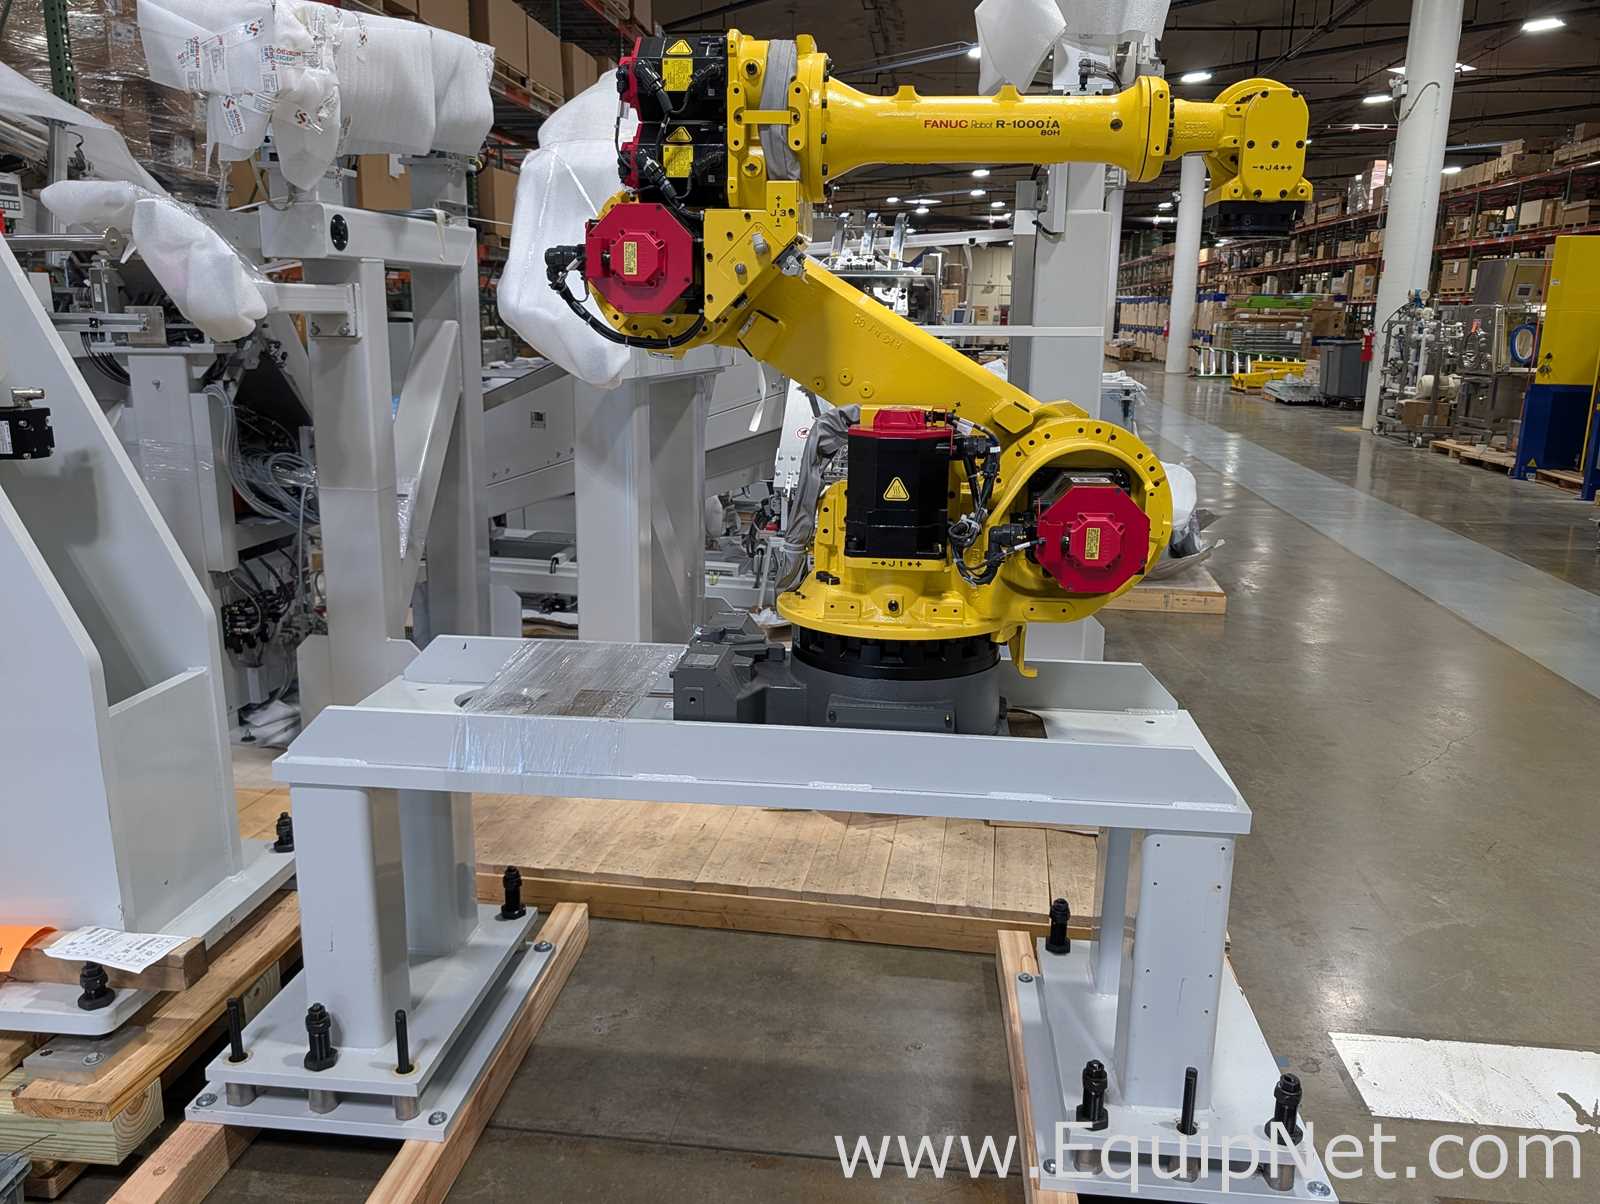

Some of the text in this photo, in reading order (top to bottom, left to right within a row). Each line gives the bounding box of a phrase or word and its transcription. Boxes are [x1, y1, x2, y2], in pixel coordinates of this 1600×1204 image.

[923, 116, 1060, 128] FANUC Robot R-1000iA
